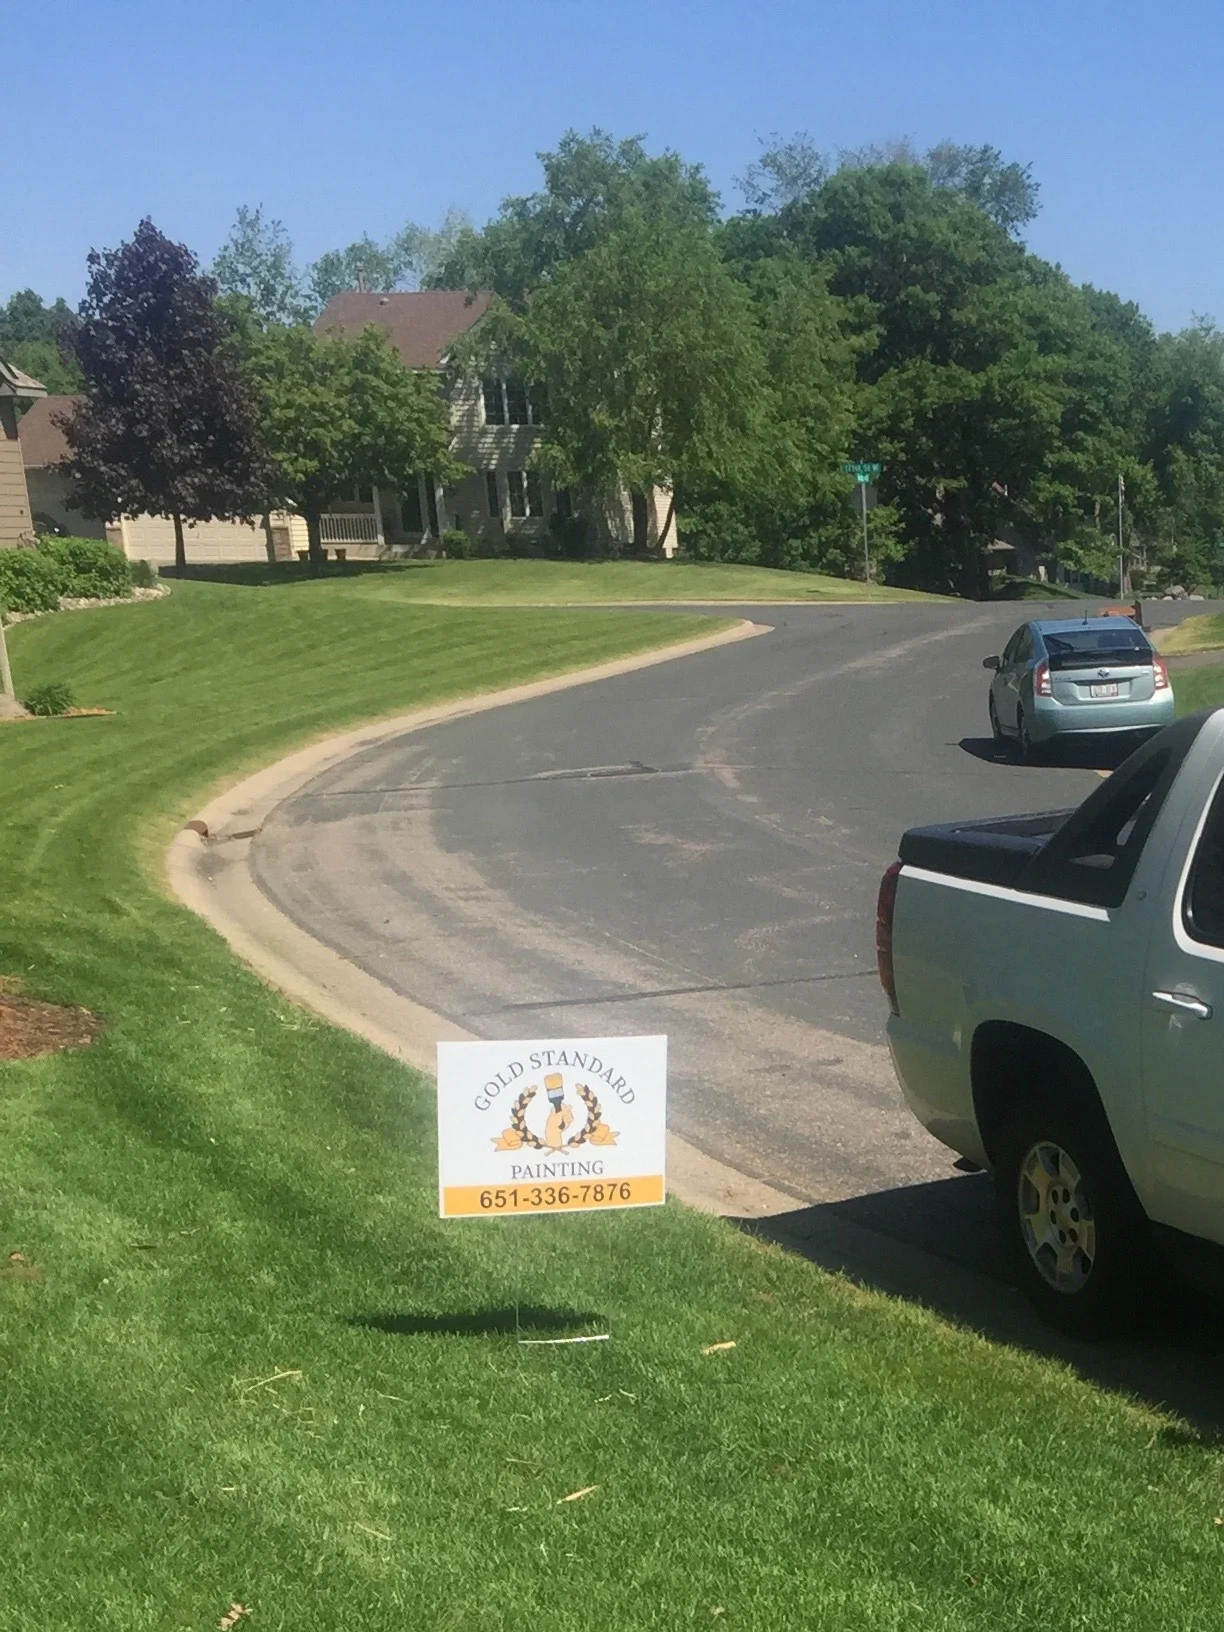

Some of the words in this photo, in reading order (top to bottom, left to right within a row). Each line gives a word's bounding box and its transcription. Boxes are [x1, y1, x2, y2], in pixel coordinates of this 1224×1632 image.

[474, 1061, 524, 1112] GOLD
[530, 1050, 635, 1105] STANDARD
[511, 1161, 604, 1179] PAINTING
[480, 1182, 631, 1208] 651-336-7876
